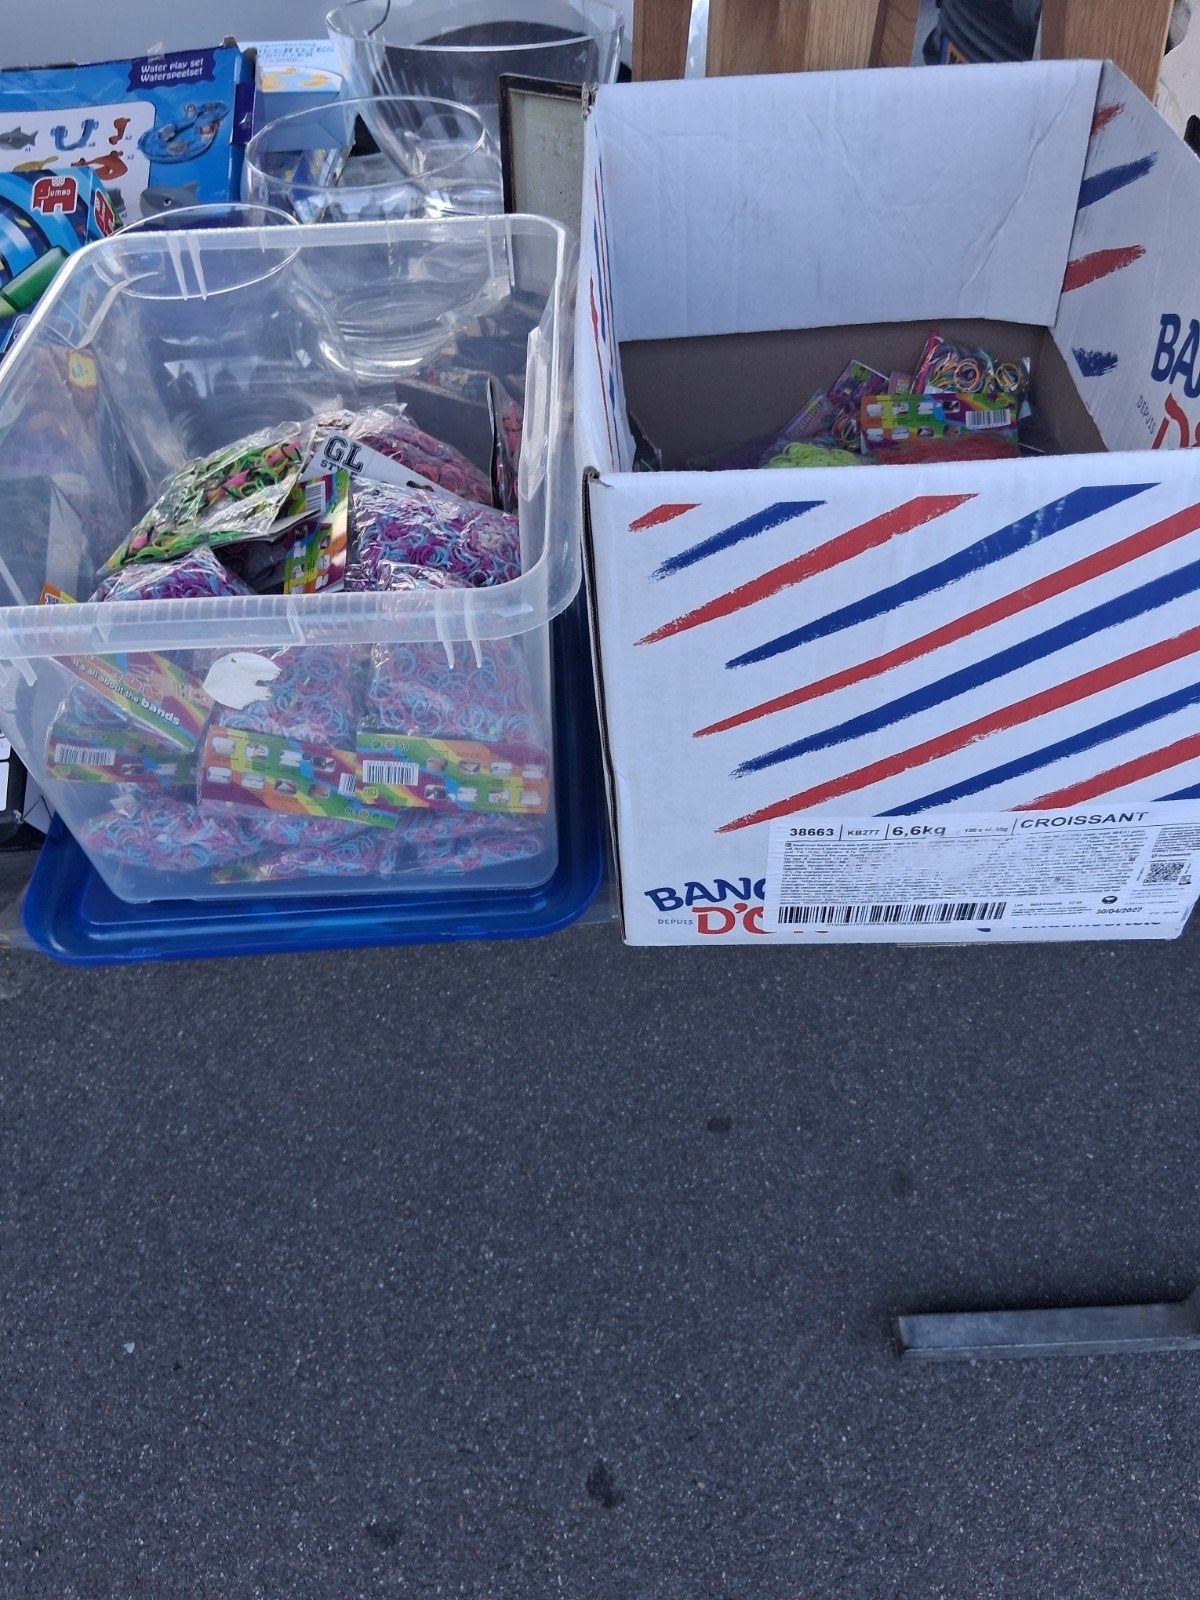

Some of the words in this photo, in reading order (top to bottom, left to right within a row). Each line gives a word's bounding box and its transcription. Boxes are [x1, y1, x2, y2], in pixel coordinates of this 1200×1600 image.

[140, 67, 203, 82] Waterspeelset
[141, 63, 167, 73] Water
[170, 60, 188, 71] play
[190, 58, 204, 67] set
[1151, 313, 1200, 398] BA
[1136, 395, 1157, 434] DEPUIS
[323, 436, 364, 473] GL
[73, 659, 86, 672] It's
[87, 669, 98, 680] all
[99, 676, 124, 696] about
[125, 688, 139, 703] the
[141, 697, 181, 726] bands
[1020, 811, 1150, 829] CROISSANT
[789, 828, 834, 837] 38663
[892, 825, 947, 838] 6,6kg
[692, 902, 776, 935] D'O
[1096, 906, 1143, 915] 30/04/2027
